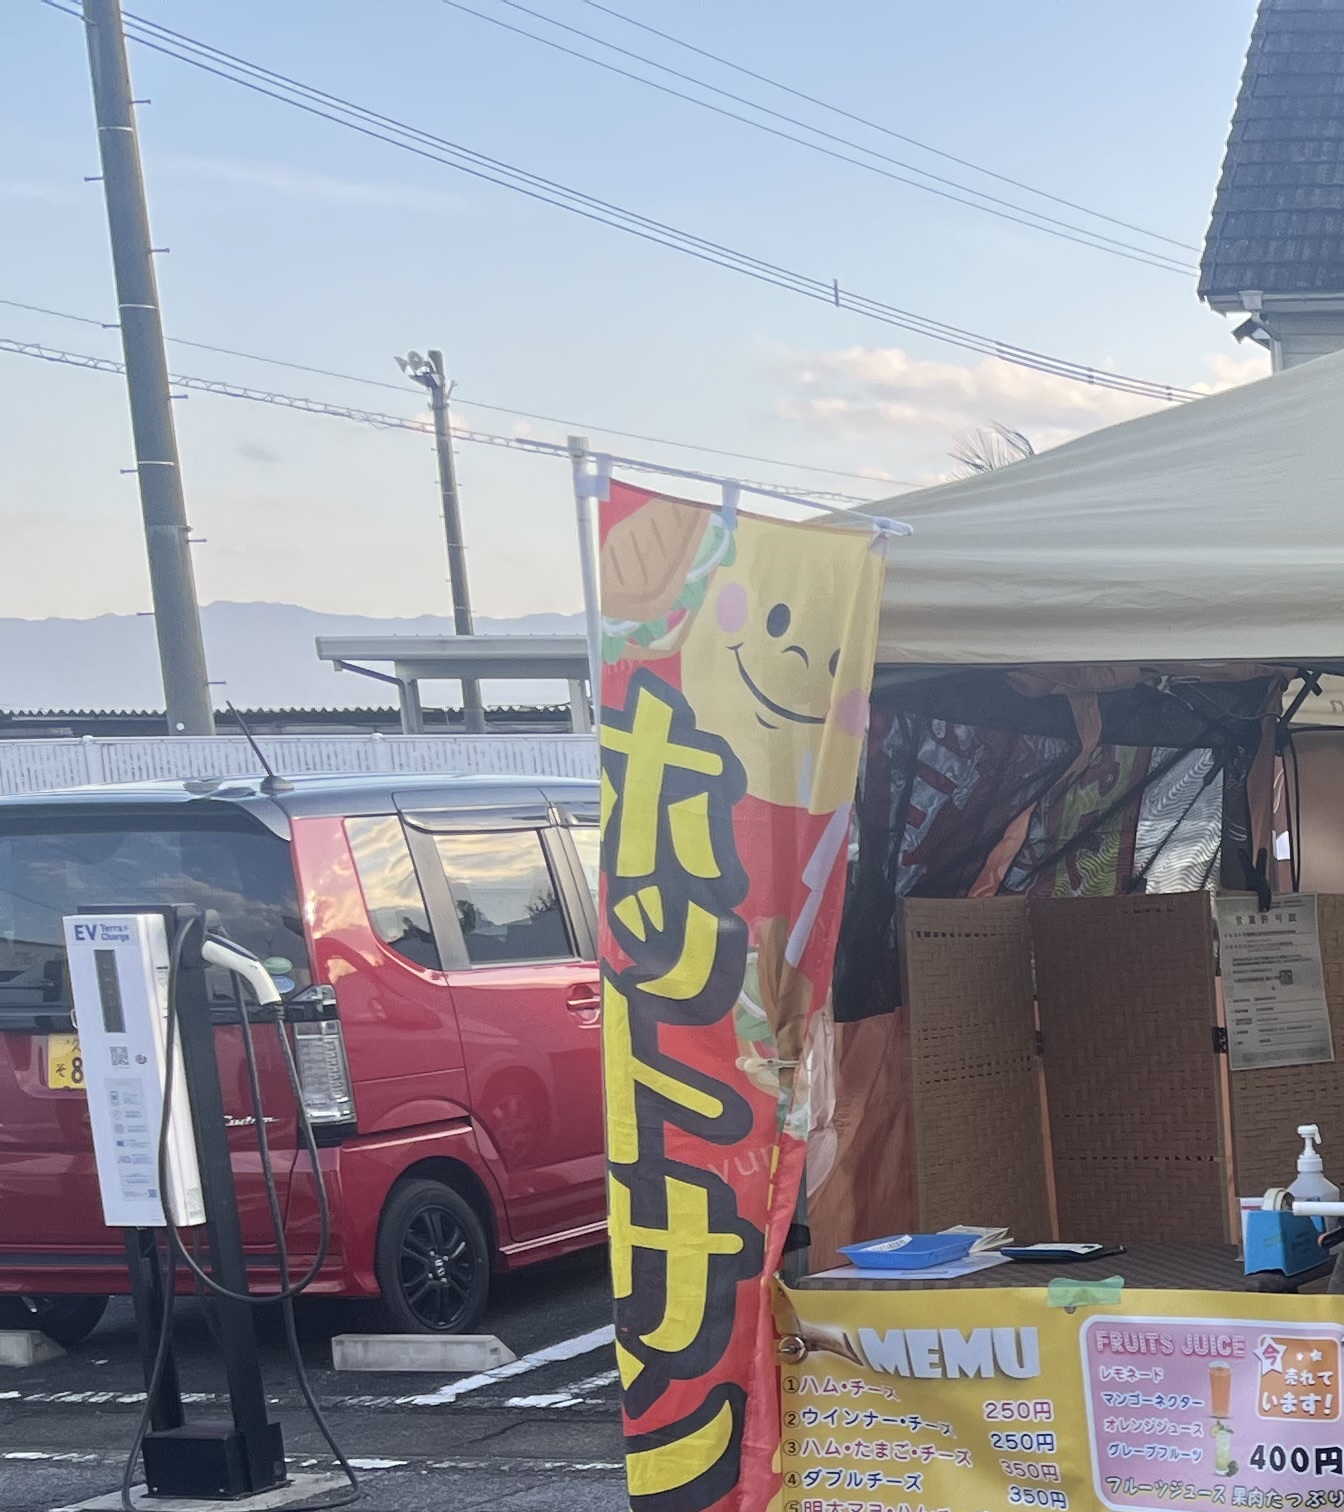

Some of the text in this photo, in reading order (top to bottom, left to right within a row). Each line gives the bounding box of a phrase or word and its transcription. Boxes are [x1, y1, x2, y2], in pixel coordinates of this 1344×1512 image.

[74, 924, 97, 941] EV
[858, 1326, 1042, 1380] MEMU
[1095, 1330, 1247, 1358] FRUITS JUICE
[1099, 1365, 1164, 1384] レモネード
[1284, 1368, 1334, 1386] 売れて
[983, 1400, 1055, 1422] 250円
[1102, 1392, 1204, 1411] マンゴーネクター
[1262, 1392, 1334, 1416] います!
[1104, 1417, 1204, 1437] オレンジジュース
[990, 1432, 1056, 1453] 250円
[1107, 1442, 1203, 1463] グレープフルーツ
[1000, 1458, 1062, 1483] 350円
[1249, 1444, 1344, 1476] 400円
[1009, 1485, 1069, 1510] 350円
